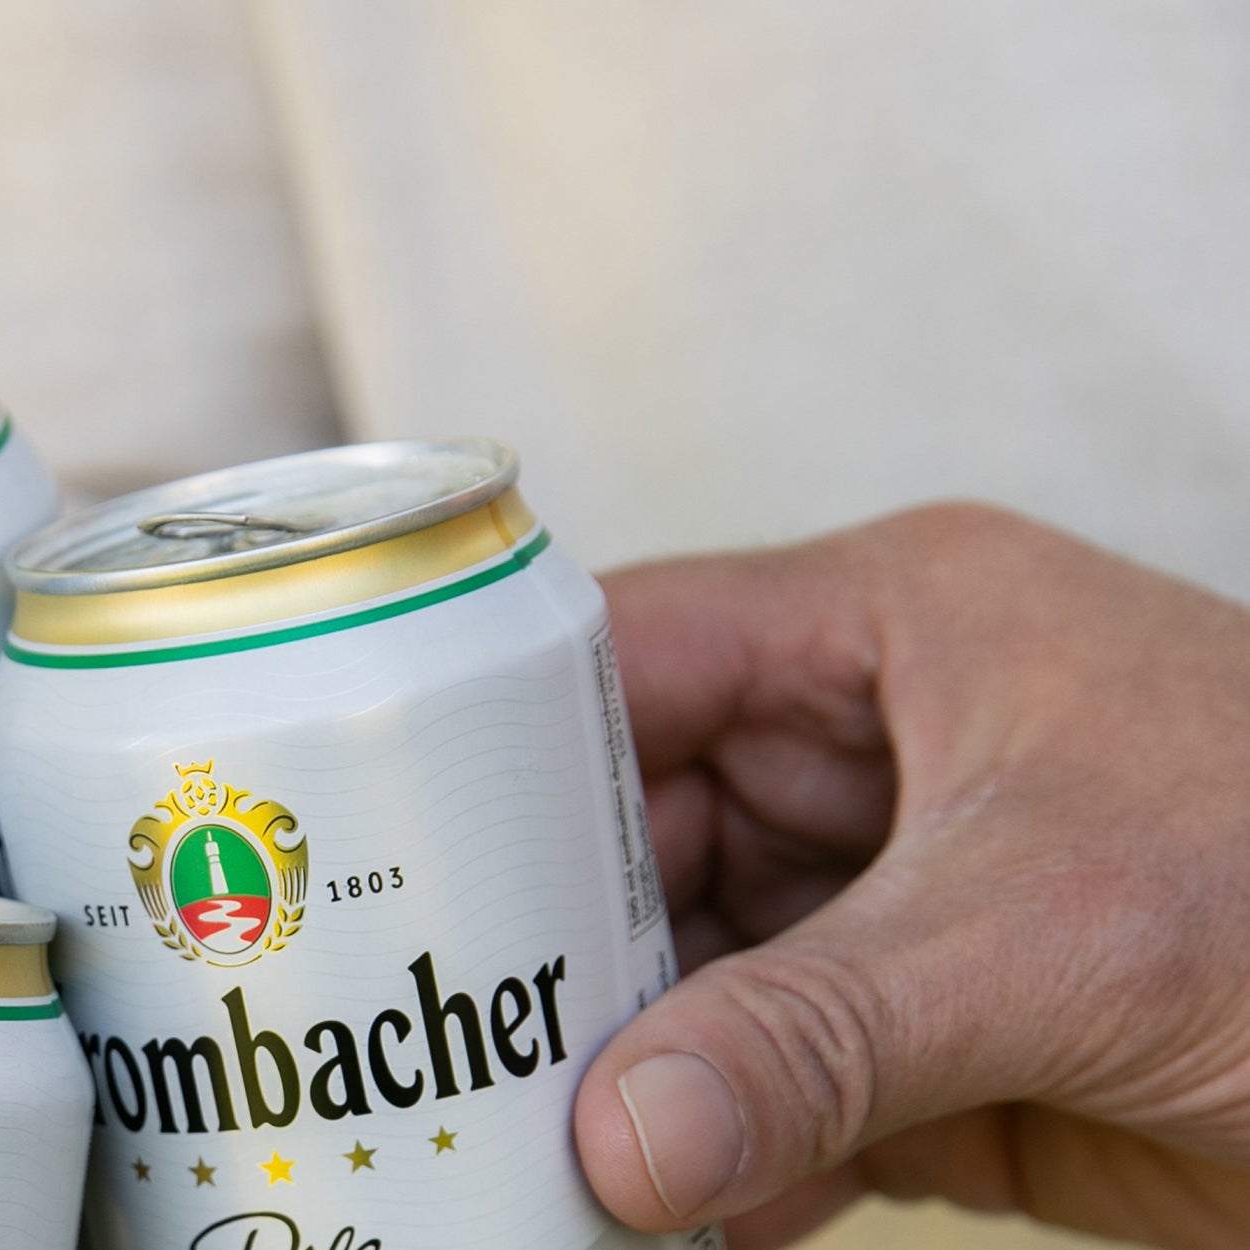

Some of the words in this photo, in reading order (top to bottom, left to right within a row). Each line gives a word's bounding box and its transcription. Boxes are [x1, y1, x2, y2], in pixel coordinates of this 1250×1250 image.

[83, 904, 130, 928] SEIT
[326, 866, 405, 903] 1803
[78, 951, 568, 1134] rombacher
